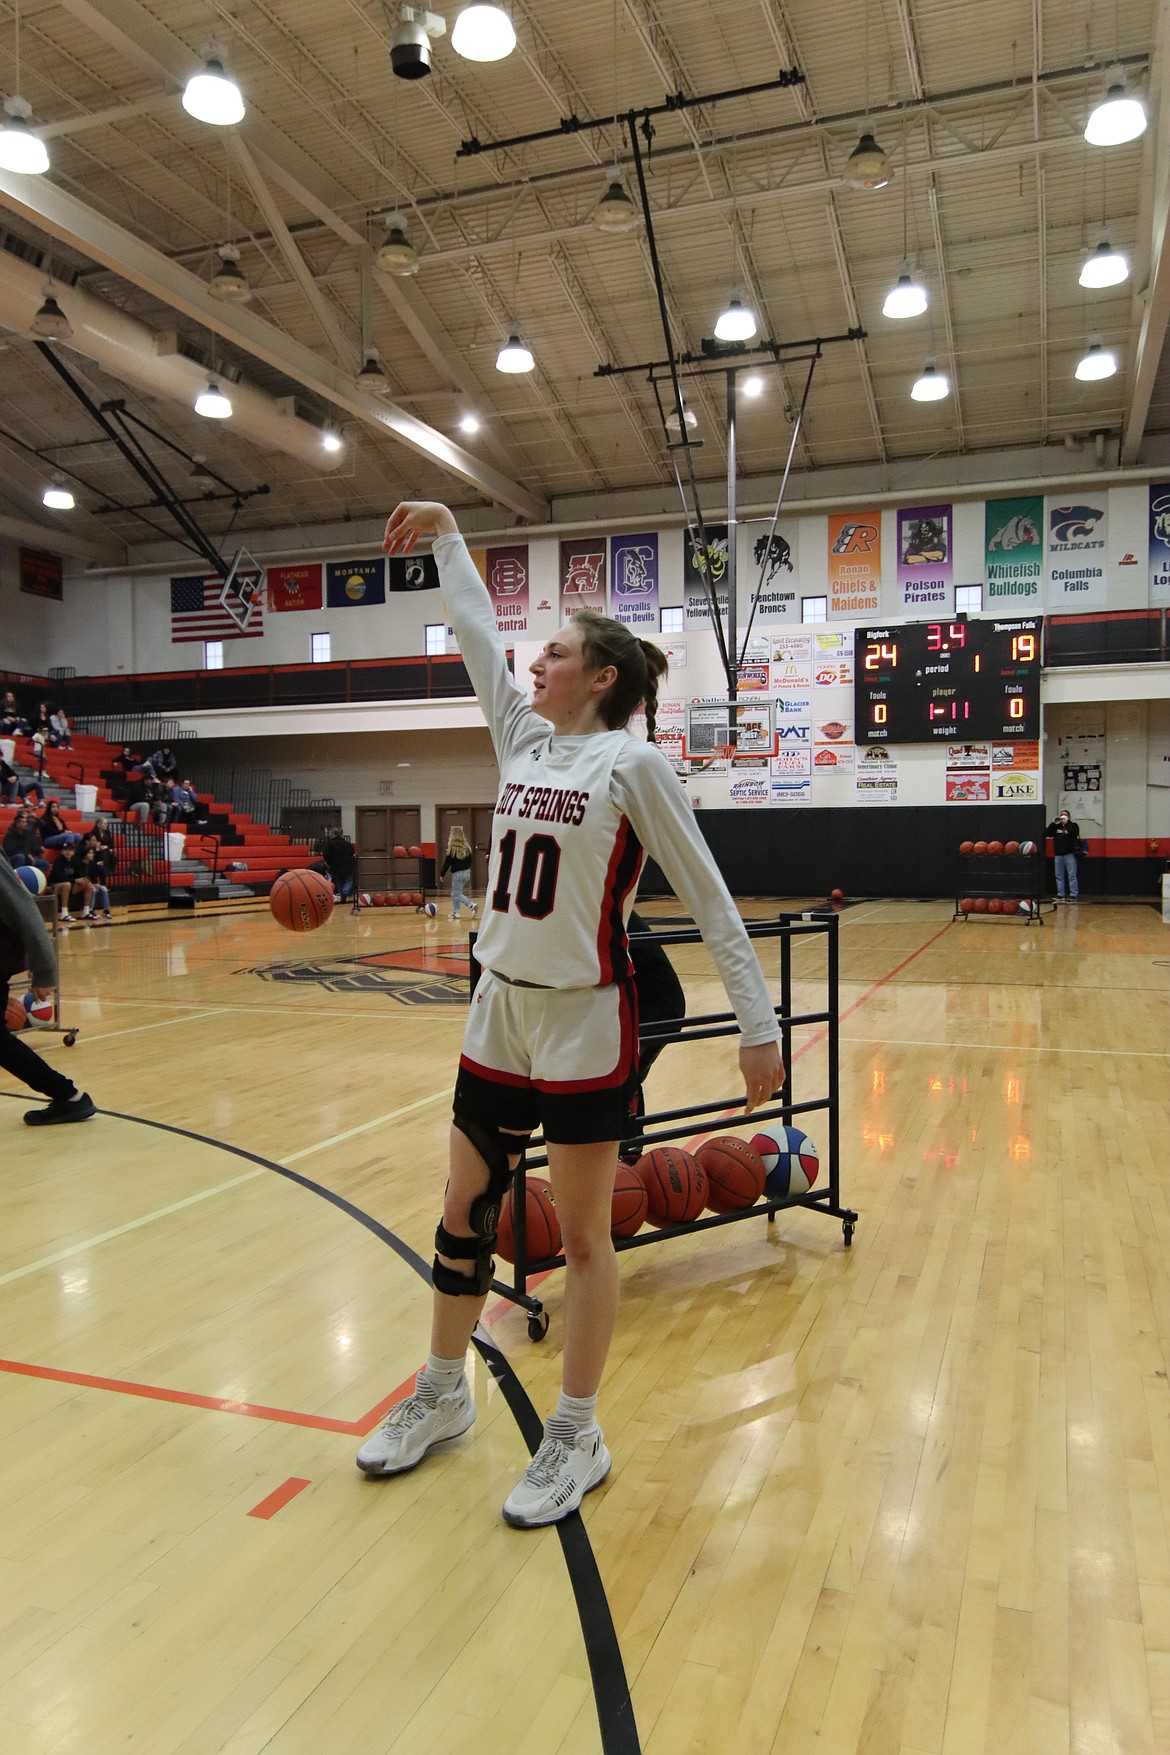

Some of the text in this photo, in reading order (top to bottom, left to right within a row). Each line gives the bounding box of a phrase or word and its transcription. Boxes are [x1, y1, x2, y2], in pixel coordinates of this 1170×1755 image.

[1050, 540, 1105, 552] WILDCATS
[334, 566, 377, 577] MONTANA
[840, 565, 869, 575] Ronan
[988, 562, 1040, 579] Whitefish
[1051, 567, 1102, 581] Columbia
[280, 571, 309, 583] FLATHEAD
[832, 579, 877, 595] Chiefs &
[905, 580, 944, 592] Polson
[989, 581, 1037, 597] Bulldogs
[1064, 580, 1089, 592] Falls
[284, 599, 305, 607] NATION
[904, 591, 945, 603] Pirates
[496, 603, 522, 617] Butte
[618, 602, 651, 614] Corvallis
[759, 604, 786, 615] Broncs
[831, 596, 878, 612] Maidens
[495, 617, 527, 632] entral
[615, 612, 655, 625] Blue Devils
[993, 620, 1036, 633] Thompson Falls
[866, 630, 890, 640] Bigfork
[927, 624, 965, 650] 3.4
[1012, 634, 1034, 662] 19
[866, 644, 897, 670] 24
[925, 664, 949, 675] period
[974, 654, 980, 673] 1
[819, 673, 835, 683] DQ
[870, 691, 887, 700] fouls
[932, 687, 956, 698] player
[1005, 685, 1023, 694] fouls
[874, 704, 887, 724] 0
[1010, 698, 1023, 718] 0
[775, 725, 810, 739] RMT
[867, 729, 888, 738] match
[933, 725, 957, 736] weight
[1003, 723, 1022, 734] match
[732, 780, 766, 789] RAINBOW
[729, 788, 769, 797] SEPTIC SERVICE
[996, 785, 1034, 798] LAKE
[518, 786, 589, 826] SPRINGS
[491, 828, 562, 921] 10
